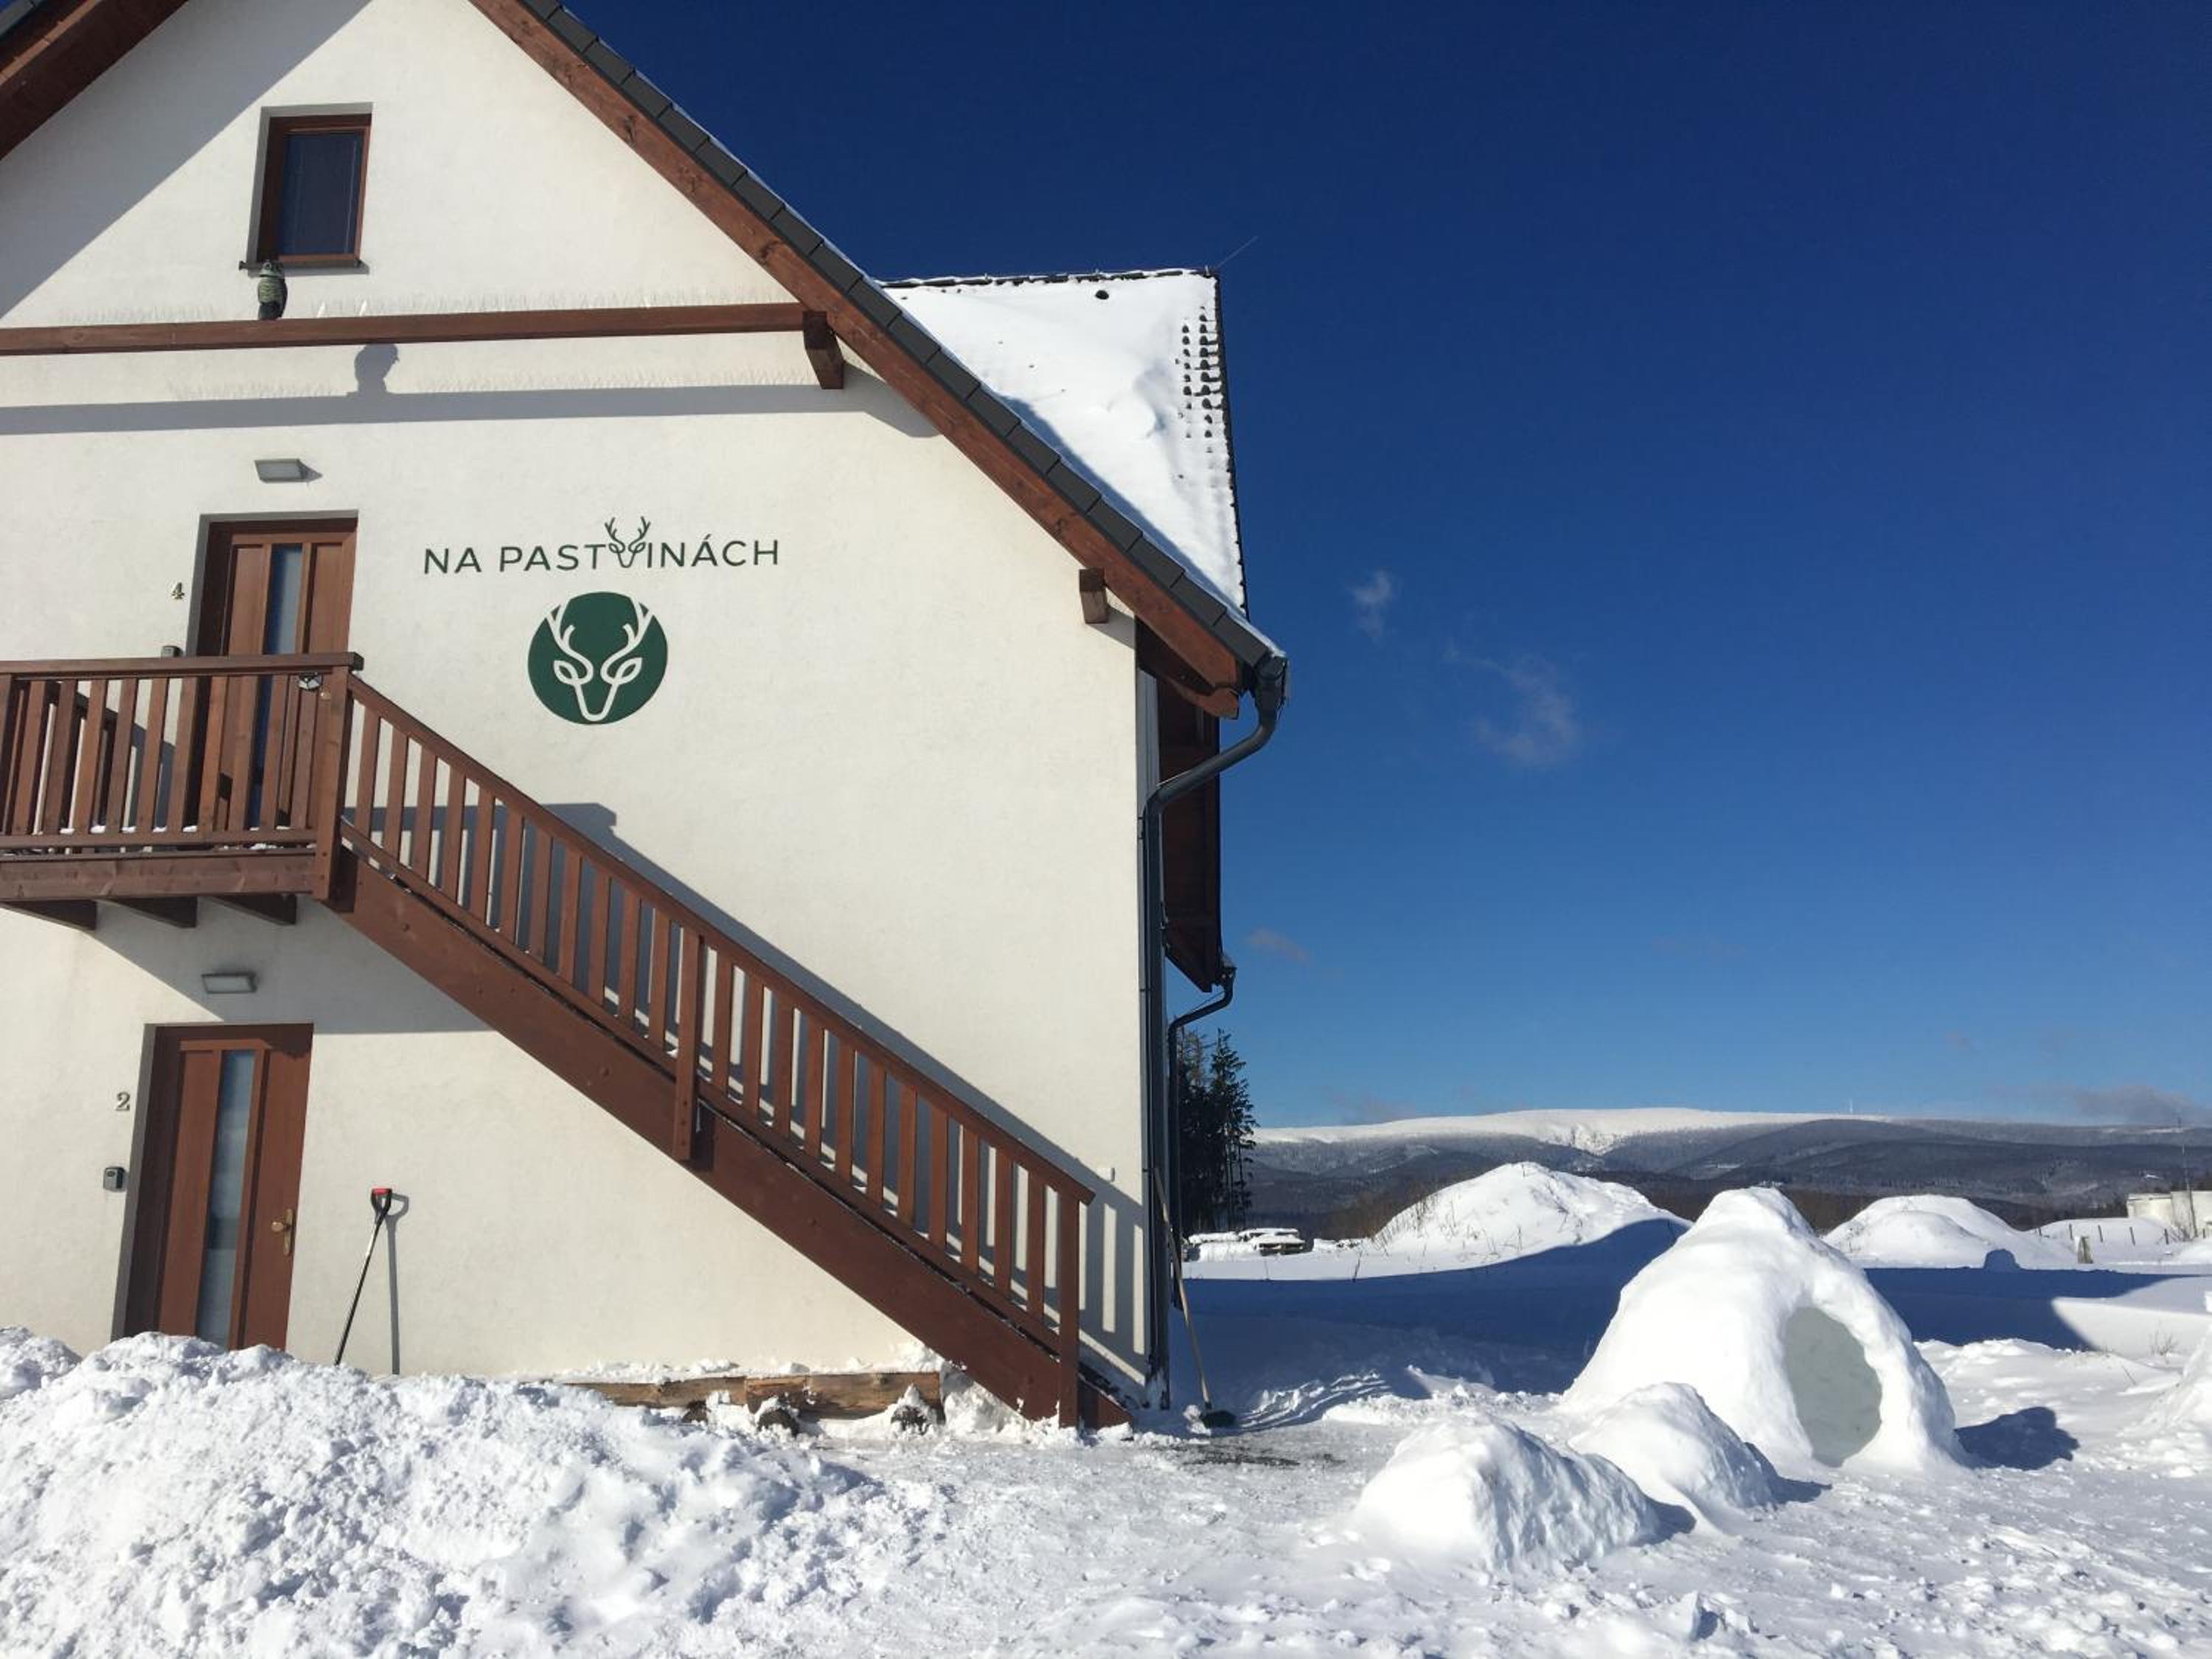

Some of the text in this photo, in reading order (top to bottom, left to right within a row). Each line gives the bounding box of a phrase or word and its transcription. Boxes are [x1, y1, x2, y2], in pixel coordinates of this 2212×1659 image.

[424, 548, 481, 574] NA
[171, 582, 185, 599] 4
[115, 1091, 131, 1111] 2
